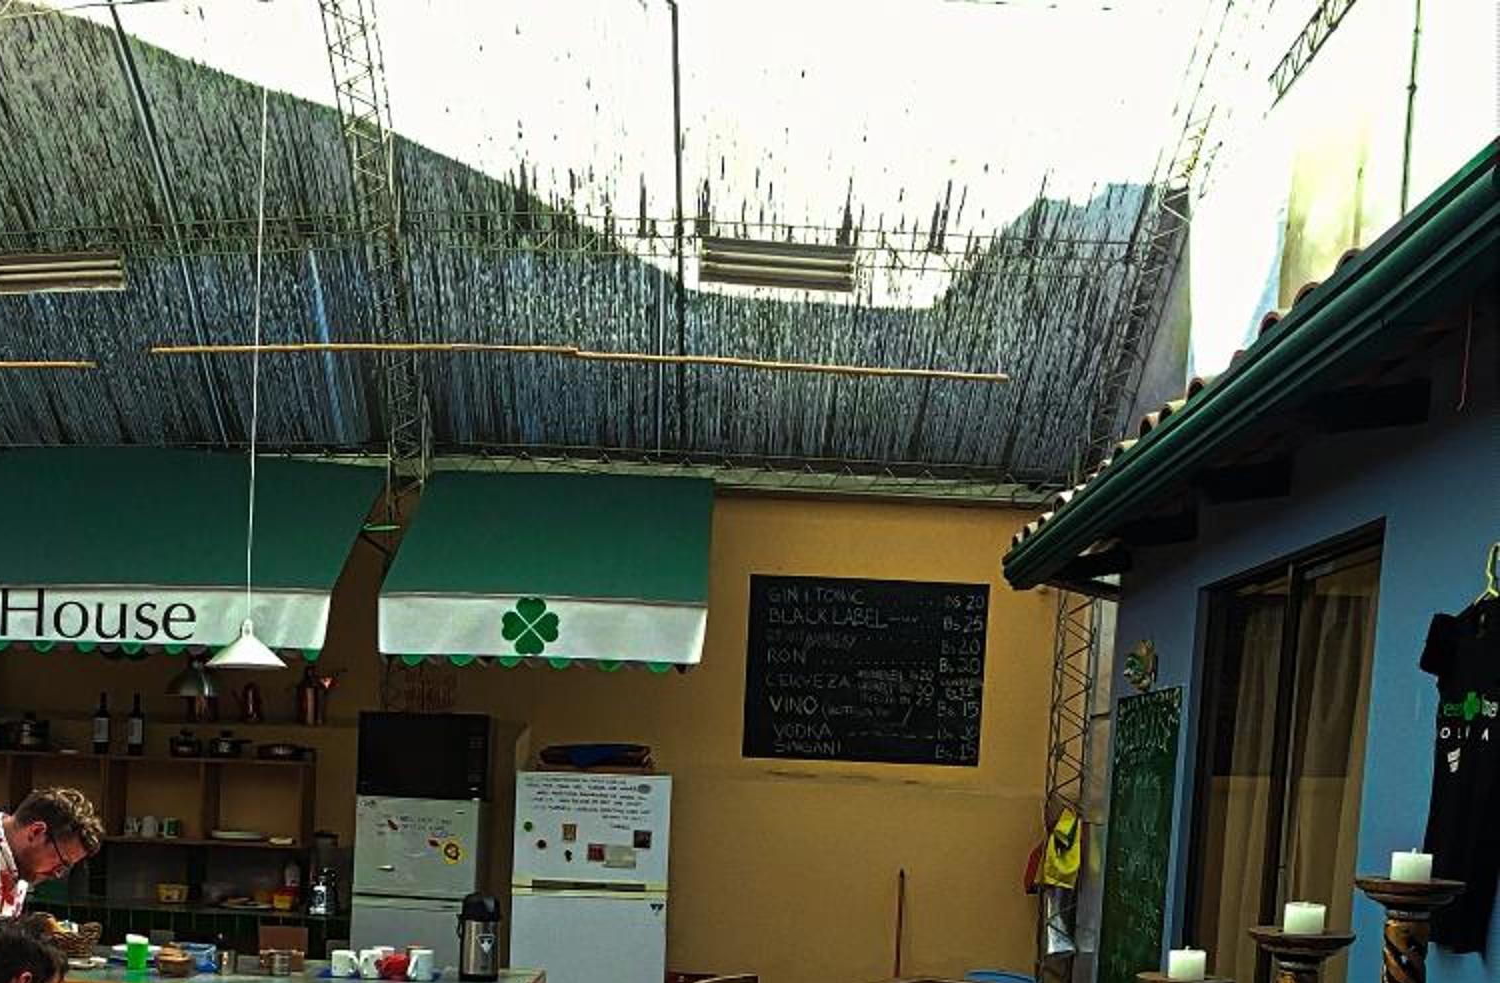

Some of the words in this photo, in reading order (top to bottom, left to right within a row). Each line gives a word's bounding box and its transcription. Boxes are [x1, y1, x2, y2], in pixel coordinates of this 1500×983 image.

[768, 585, 799, 604] GIN
[769, 607, 830, 625] BLACK
[831, 608, 888, 629] LABEL
[766, 648, 807, 664] RON
[765, 672, 850, 689] CERVEZA
[769, 695, 819, 715] VINO
[772, 722, 833, 741] VODKA
